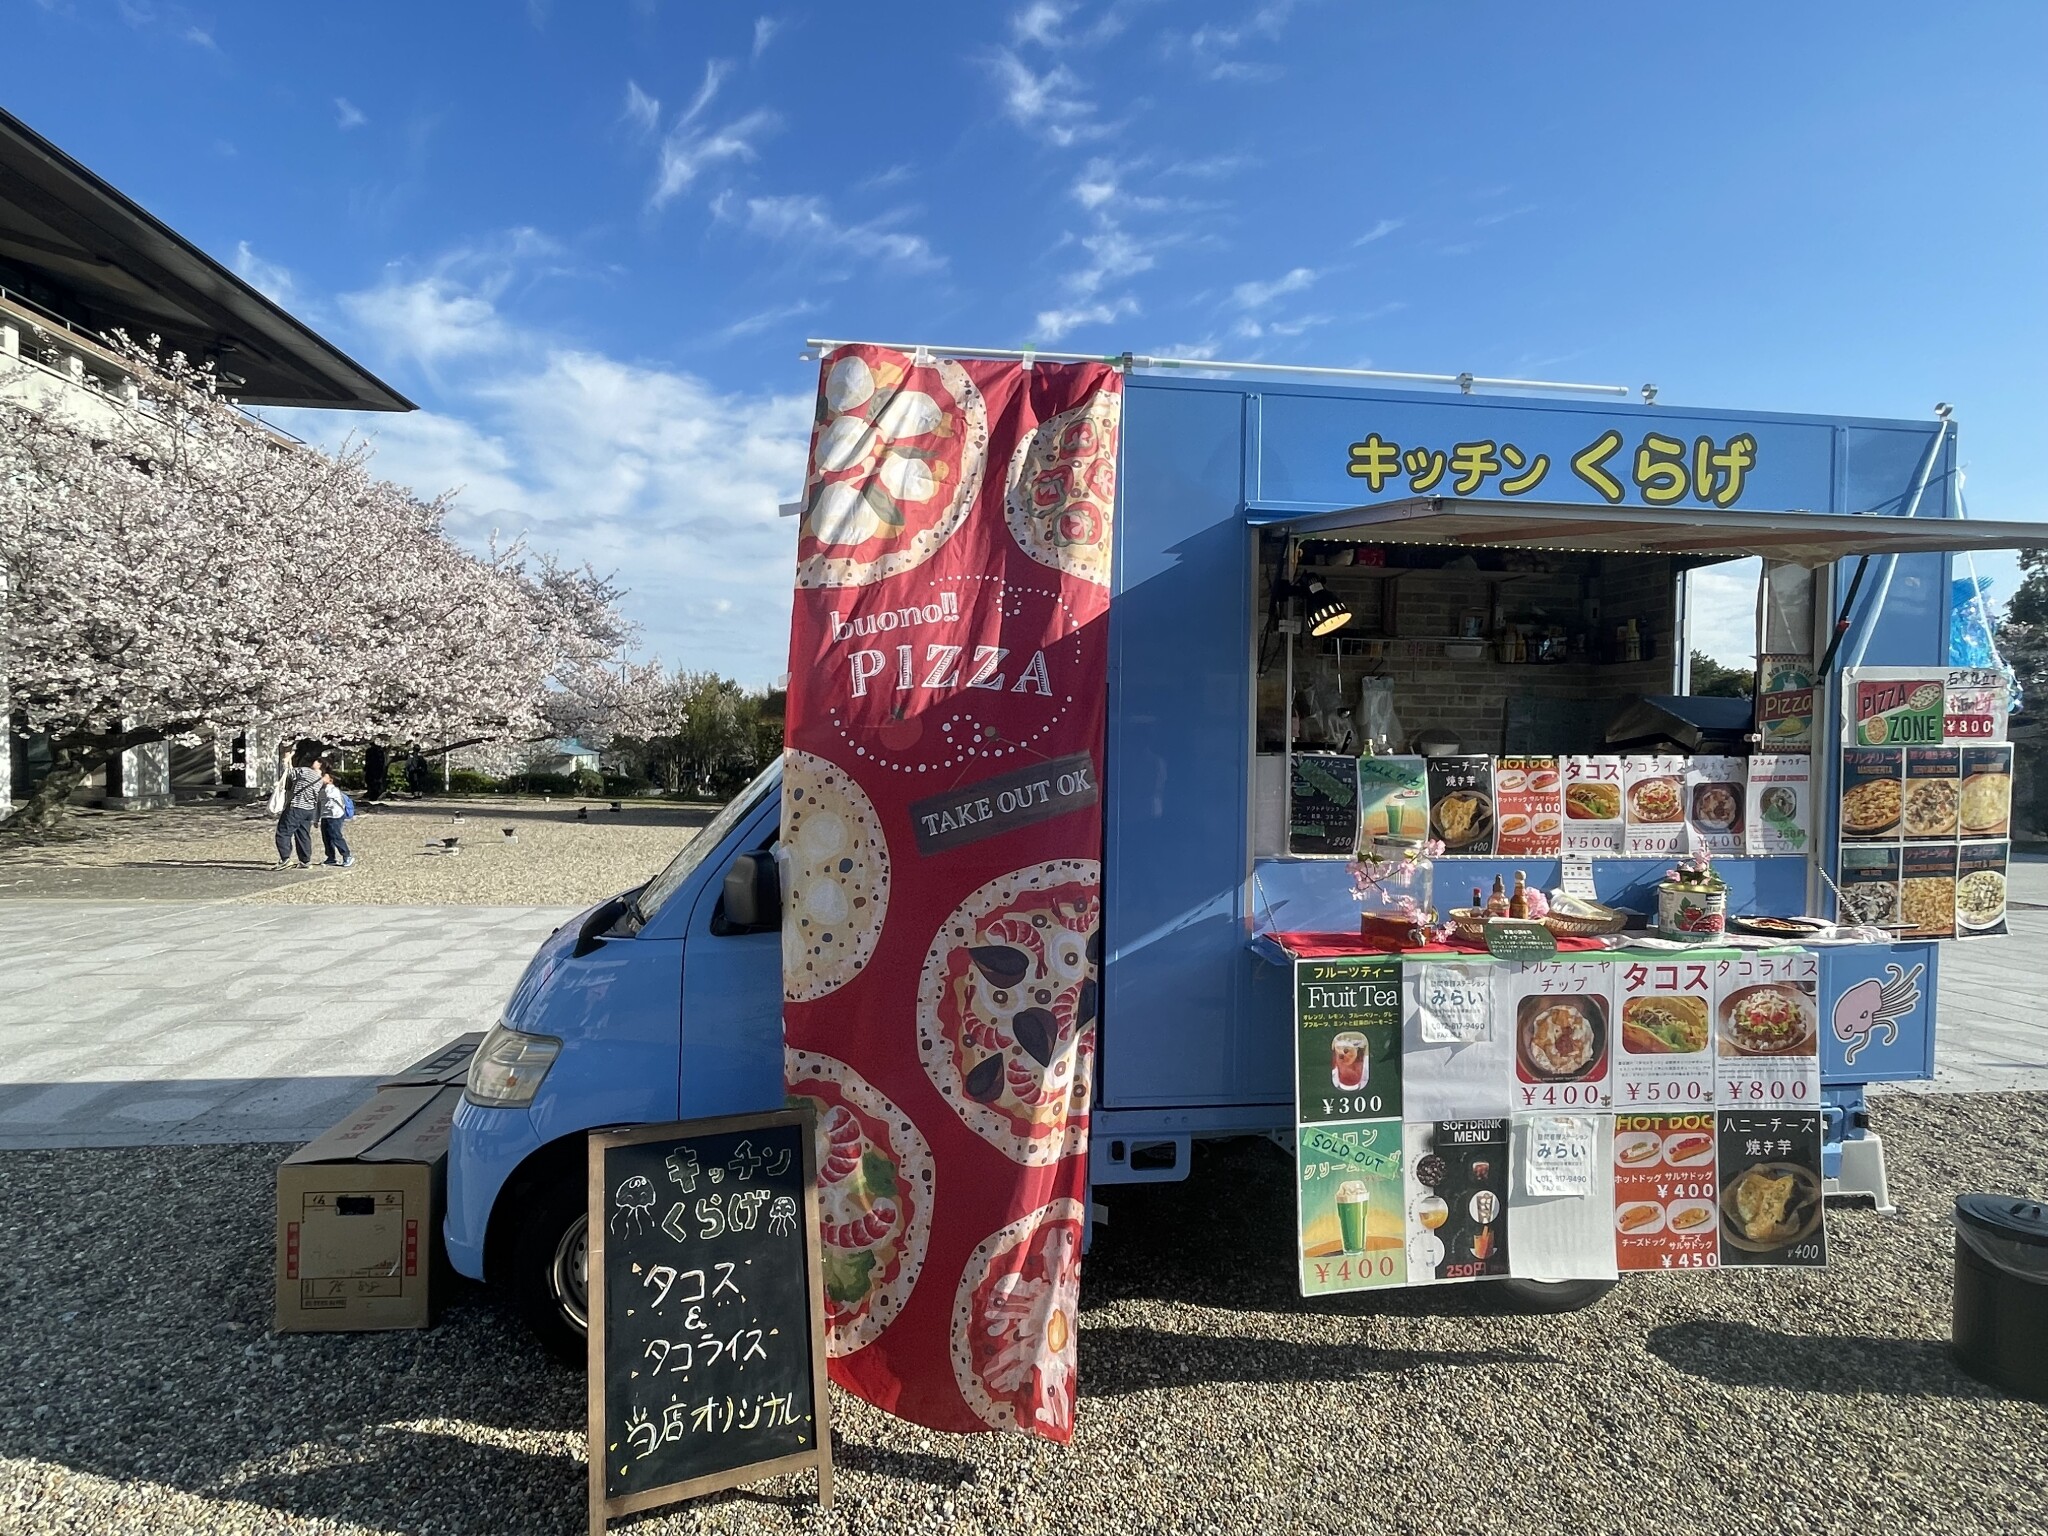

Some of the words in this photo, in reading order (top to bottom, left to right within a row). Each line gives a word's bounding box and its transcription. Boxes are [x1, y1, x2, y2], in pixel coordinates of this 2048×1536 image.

[1346, 432, 1550, 496] キッチン
[1571, 429, 1758, 508] くらげ
[830, 592, 959, 643] buono!!
[849, 644, 1053, 698] PIZZA
[1765, 695, 1813, 717] Pizza
[1863, 684, 1907, 717] PIZZA
[1890, 716, 1936, 742] ZONE
[1946, 720, 1992, 733] ¥800
[1431, 761, 1489, 772] ハニーチーズ
[1565, 762, 1620, 780] タコス
[1624, 761, 1686, 773] タコライス
[1446, 775, 1476, 786] 焼き芋
[922, 799, 992, 837] TAKE
[996, 781, 1050, 814] OUT
[1056, 768, 1091, 796] OK
[1524, 803, 1560, 812] ¥400
[1526, 847, 1560, 855] ¥450
[1568, 837, 1613, 848] ¥500
[1632, 838, 1678, 850] ¥800
[1313, 966, 1394, 978] フルーツティー
[1520, 961, 1610, 974] トルティーヤ
[1717, 958, 1818, 977] タコライス
[1541, 977, 1587, 992] チップ
[1623, 962, 1709, 992] タコス
[1308, 986, 1357, 1008] Fruit
[1359, 985, 1399, 1007] Tea
[1431, 990, 1483, 1006] みらい
[1521, 1085, 1598, 1105] ¥400
[1626, 1081, 1701, 1101] ¥500
[1728, 1080, 1806, 1100] ¥800
[1322, 1095, 1382, 1115] ¥300
[1442, 1119, 1501, 1131] SOFTDRINK
[1616, 1115, 1664, 1131] HOT
[1668, 1114, 1714, 1130] DOG
[1723, 1117, 1816, 1133] ハニーチーズ
[1454, 1130, 1490, 1142] MENU
[1311, 1134, 1350, 1156] SOLD
[1355, 1151, 1384, 1172] OUT
[1537, 1143, 1586, 1158] みらい
[1745, 1139, 1792, 1156] 焼き芋
[666, 1141, 791, 1194] キッチン
[1615, 1174, 1661, 1183] ホットドッグ
[1665, 1171, 1713, 1181] サルサドッグ
[1657, 1183, 1713, 1198] ¥400
[661, 1189, 770, 1243] くらげ
[1622, 1238, 1667, 1247] チーズドッグ
[1669, 1241, 1713, 1250] サルサドッグ
[1661, 1252, 1717, 1268] ¥450
[1787, 1244, 1819, 1259] ¥400
[1314, 1256, 1394, 1283] ¥400
[1446, 1261, 1486, 1277] 250円
[643, 1262, 740, 1308] タコス
[643, 1329, 767, 1377] タコライス
[625, 1391, 800, 1460] 当店オリジナル
